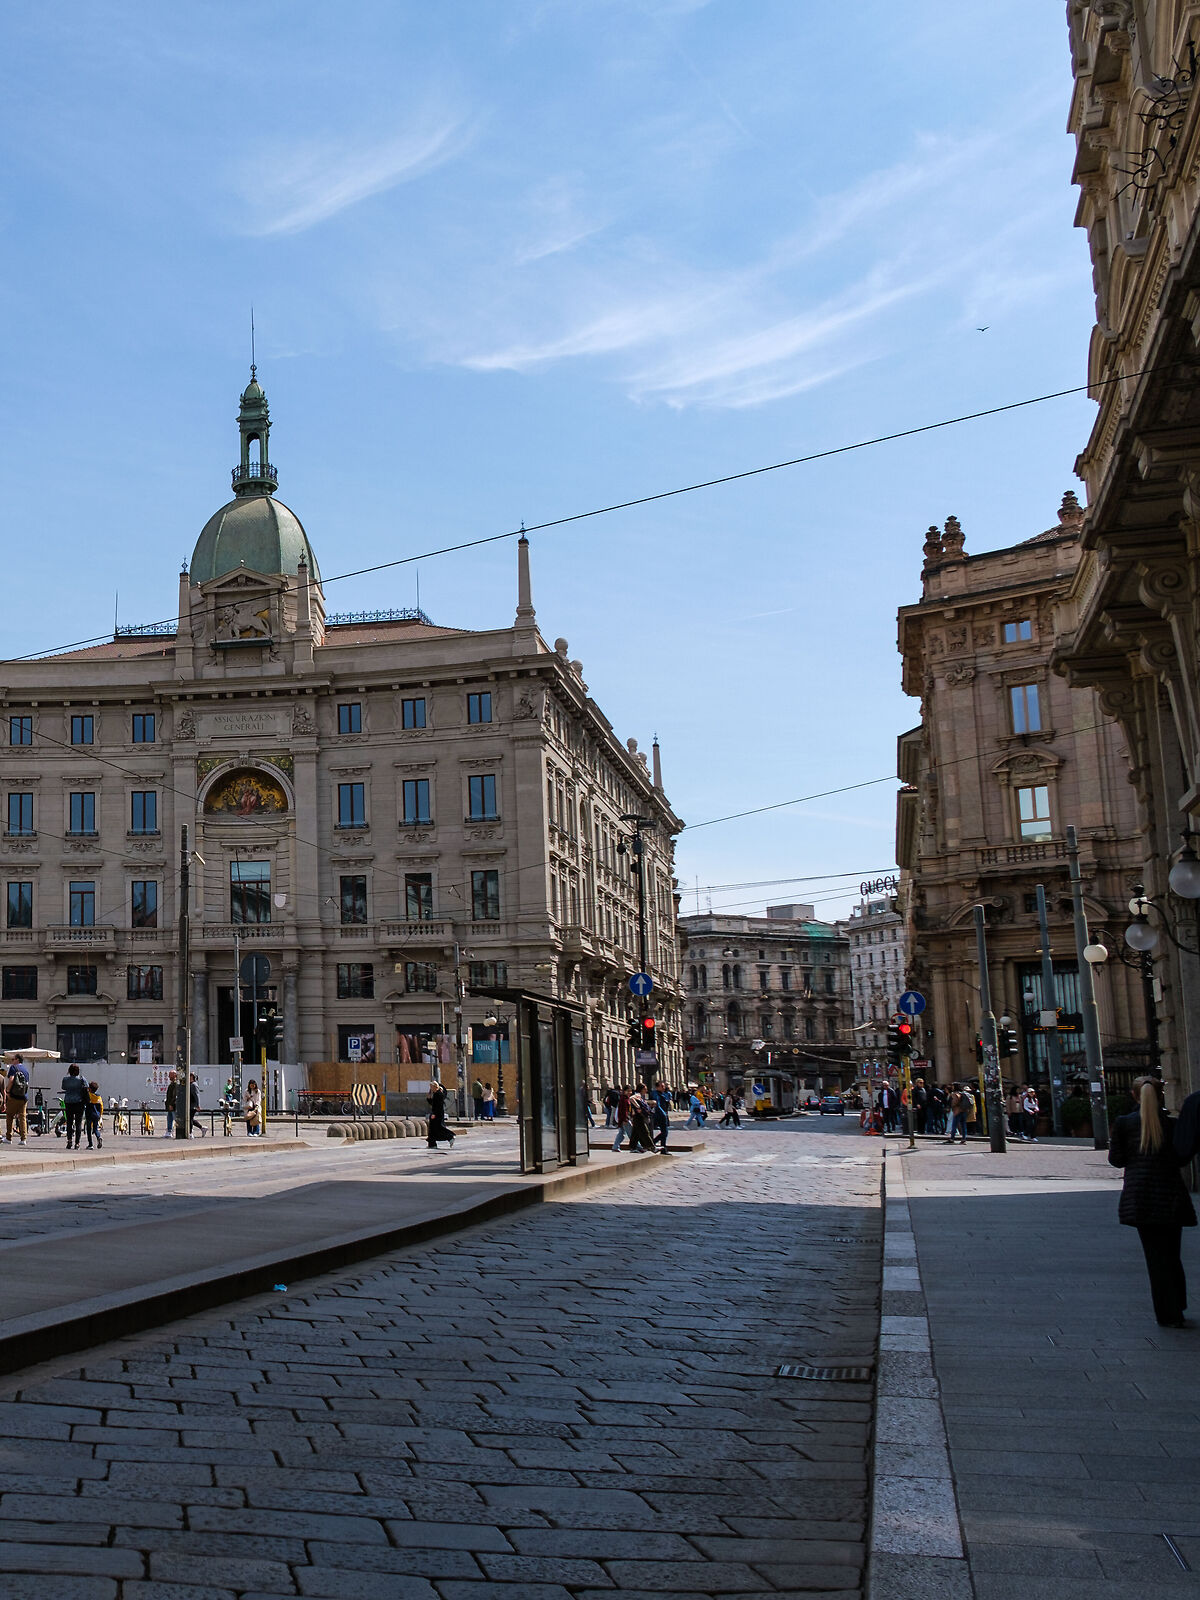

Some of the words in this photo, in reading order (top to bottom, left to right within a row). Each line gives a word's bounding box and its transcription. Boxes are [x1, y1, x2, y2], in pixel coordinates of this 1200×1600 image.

[214, 713, 276, 723] ASSICURAZIONI
[224, 722, 264, 731] GENERALI
[860, 874, 896, 896] GUCCI
[351, 1039, 360, 1049] P
